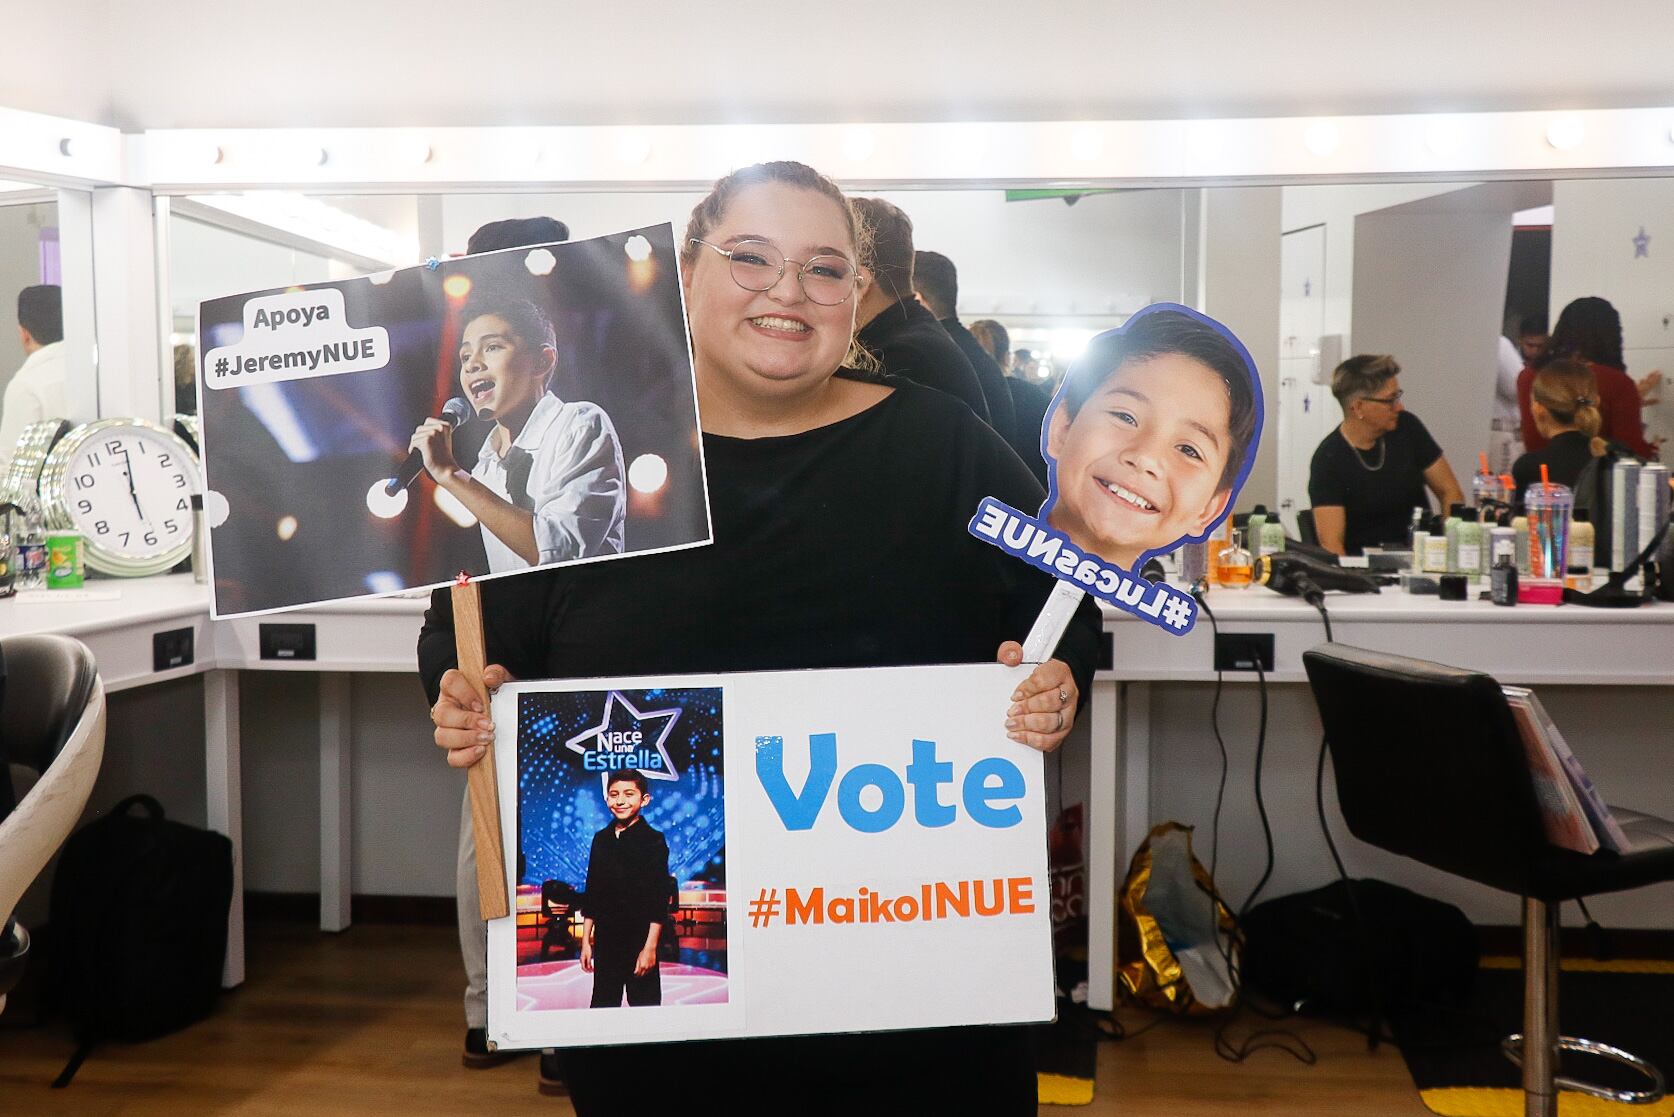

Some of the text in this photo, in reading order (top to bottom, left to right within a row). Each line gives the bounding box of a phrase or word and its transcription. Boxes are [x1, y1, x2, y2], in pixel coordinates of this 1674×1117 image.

[253, 304, 330, 331] Apoya
[215, 338, 375, 378] #JeremyNUE
[105, 440, 127, 456] 12
[138, 441, 146, 454] 1
[87, 452, 101, 467] 11
[157, 453, 173, 468] 2
[74, 473, 95, 490] 10
[173, 474, 187, 488] 3
[78, 499, 92, 515] 9
[176, 498, 188, 511] 4
[94, 520, 110, 535] 8
[164, 519, 178, 534] 5
[118, 532, 130, 547] 7
[144, 531, 158, 546] 6
[597, 730, 643, 752] Nace
[614, 744, 634, 753] una
[583, 749, 662, 770] Estrella
[755, 732, 1026, 833] Vote
